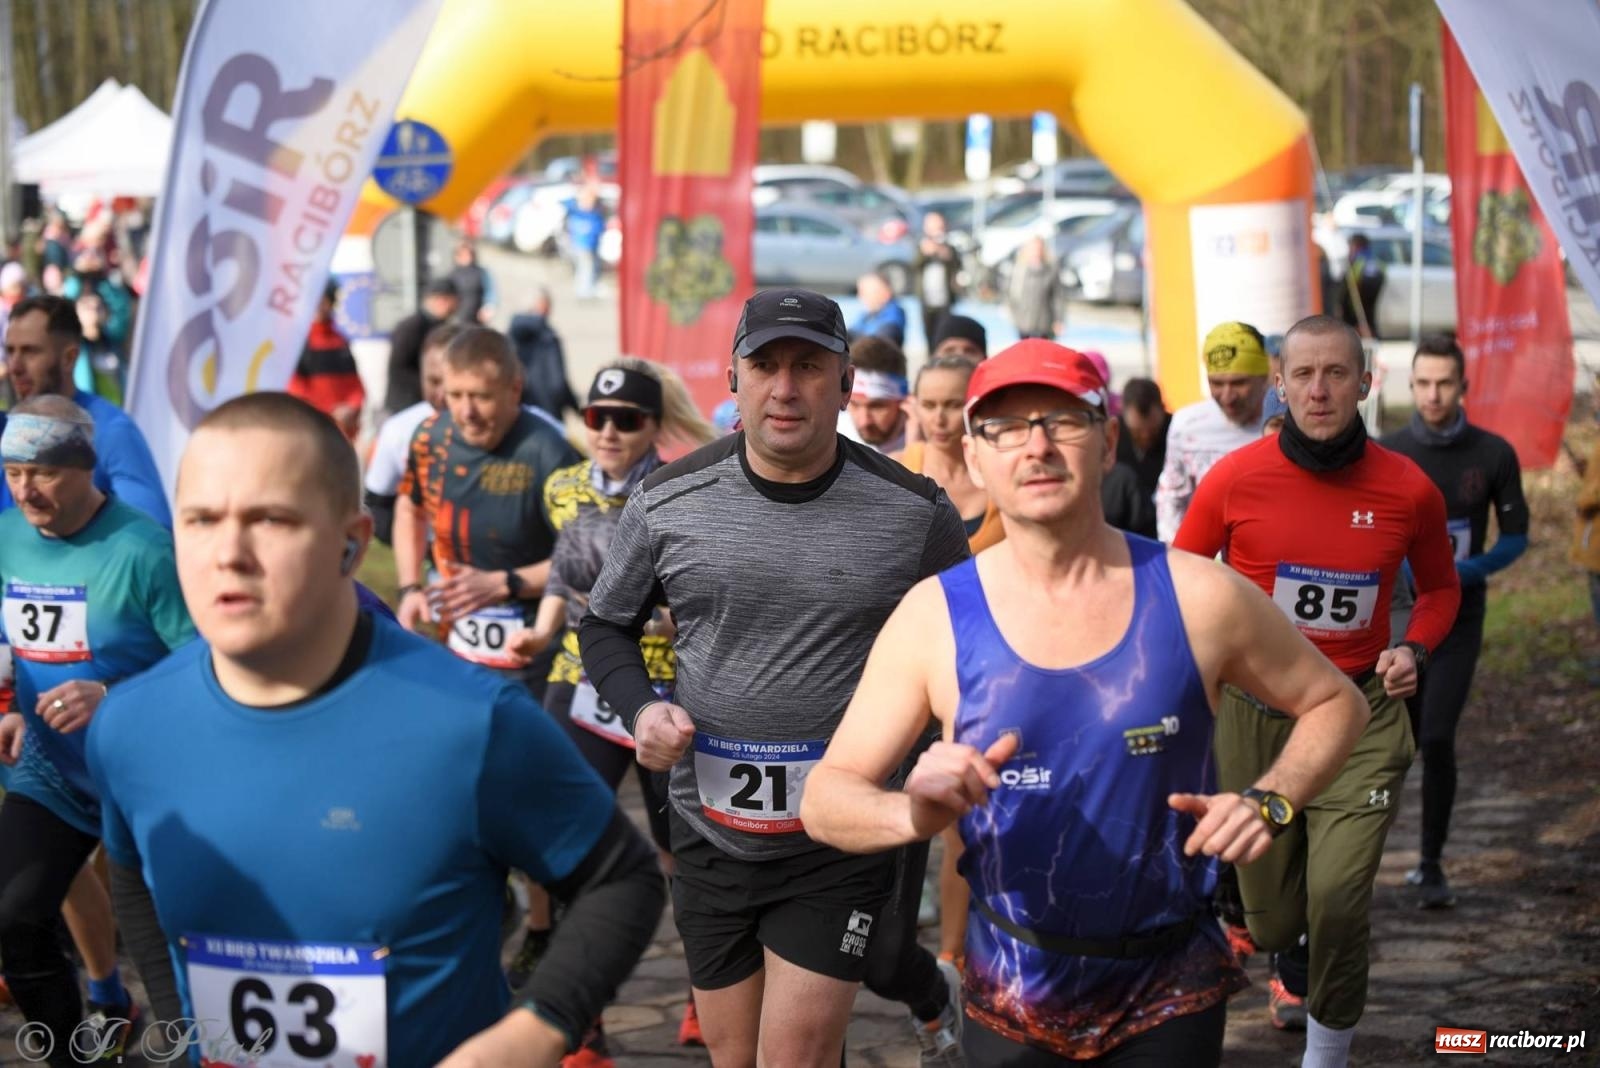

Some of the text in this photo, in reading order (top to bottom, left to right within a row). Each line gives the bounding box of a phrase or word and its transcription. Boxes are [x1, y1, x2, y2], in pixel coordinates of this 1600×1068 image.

[797, 15, 1006, 58] RACIBÓRZ
[267, 89, 380, 317] RACIBÓRZ
[1301, 567, 1320, 577] BIEG
[1321, 570, 1371, 581] TWARDZIELA
[1294, 584, 1359, 624] 85
[21, 603, 63, 643] 37
[465, 619, 505, 650] 30
[1161, 715, 1180, 736] 10
[708, 737, 809, 754] XII BIEG TWARDZIELA
[741, 752, 763, 761] lutego
[729, 763, 787, 812] 21
[733, 818, 769, 830] Racibórz
[205, 937, 360, 965] XII BIEG TWARDZIELA
[230, 975, 339, 1062] 63
